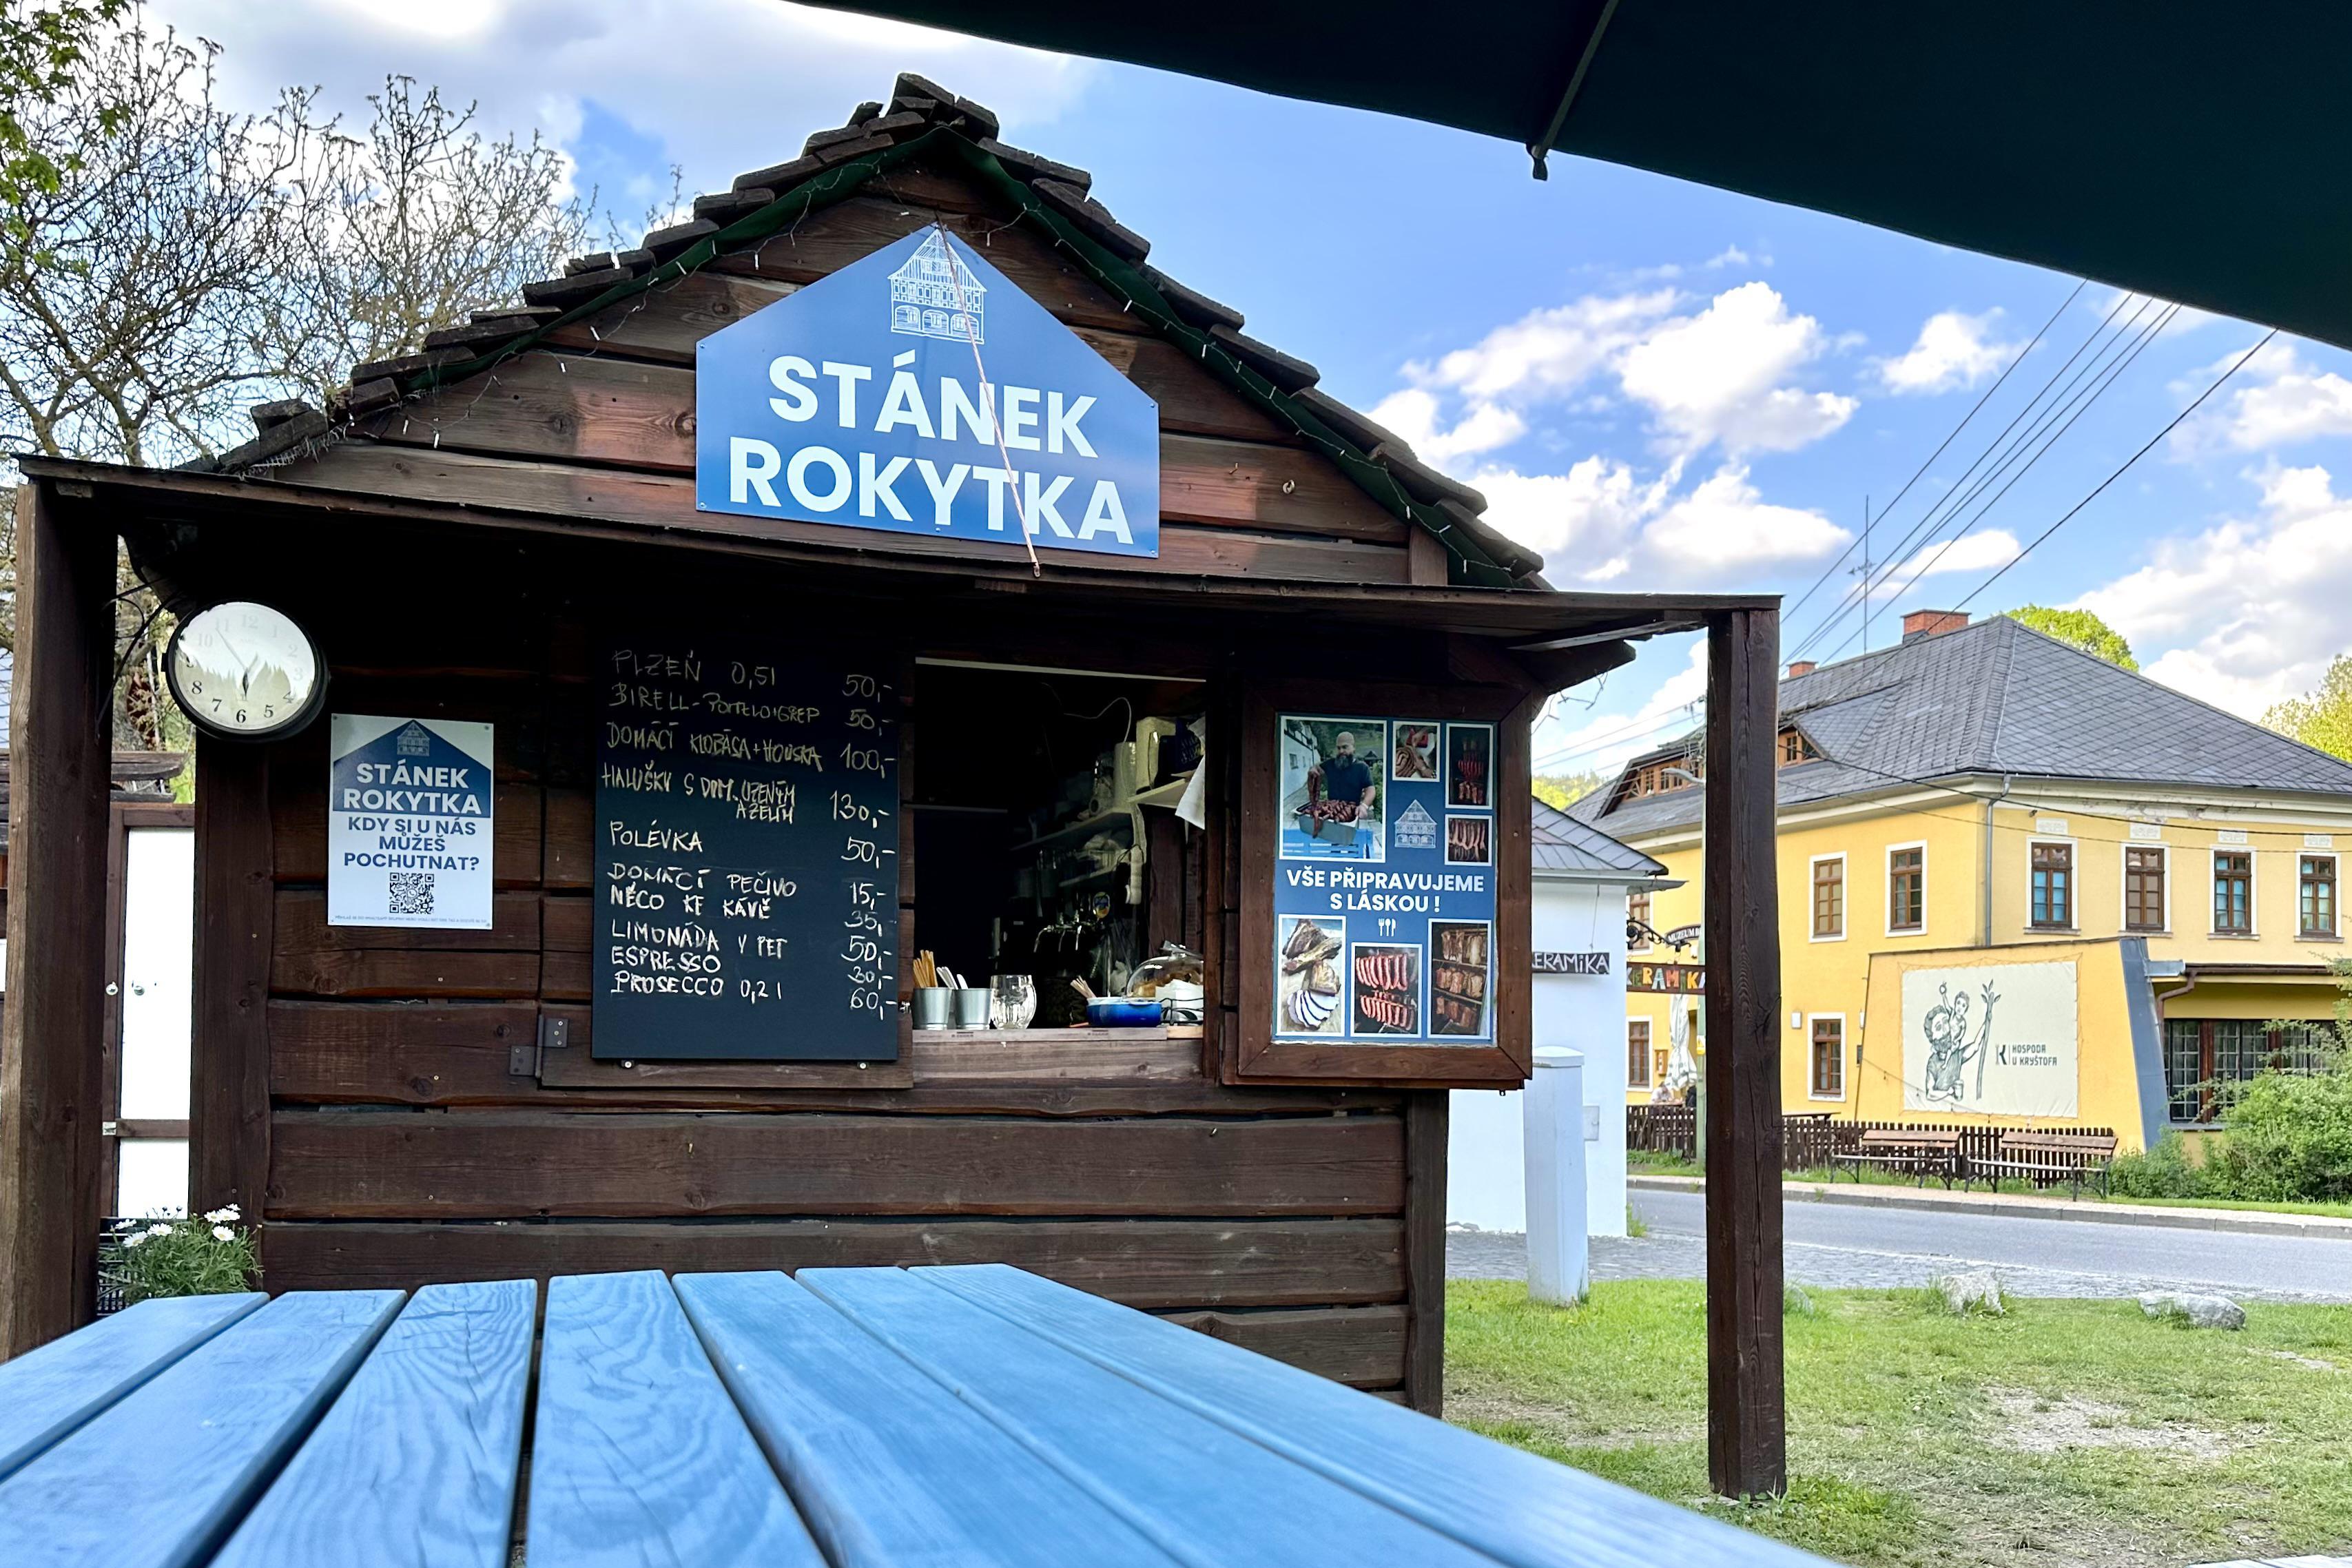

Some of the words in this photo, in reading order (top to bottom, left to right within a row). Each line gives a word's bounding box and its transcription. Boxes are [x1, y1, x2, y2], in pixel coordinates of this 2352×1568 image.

[769, 349, 1097, 457] STÁNEK
[730, 436, 1133, 544] ROKYTKA
[243, 614, 258, 628] 12
[198, 633, 213, 647] 10
[288, 644, 298, 657] 2
[192, 681, 203, 694] 8
[609, 682, 689, 710] BIRELL
[212, 698, 222, 712] 7
[264, 705, 274, 718] 5
[236, 709, 246, 723] 6
[356, 759, 469, 789] STÁNEK
[684, 773, 694, 795] S
[343, 788, 482, 815] ROKYTKA
[348, 816, 389, 832] KDY
[394, 818, 412, 833] SI
[417, 820, 430, 834] U
[435, 816, 476, 835] NÁS
[379, 831, 446, 852] MŮŽEŠ
[610, 820, 703, 853] POLÉVKA
[344, 853, 479, 871] POCHUTNAT?
[727, 871, 796, 896] PEČIVO
[1286, 865, 1325, 888] VŠE
[1330, 867, 1485, 893] PŘIPRAVUJEME
[610, 881, 665, 911] NĚCO
[683, 894, 704, 916] KE
[723, 897, 771, 920] KÁVĚ
[1330, 894, 1344, 911] S
[1347, 891, 1430, 912] LÁSKOU
[612, 919, 719, 952] LIMONÁDA
[757, 935, 787, 960] PET
[612, 947, 721, 973] ESPRESSO
[610, 971, 724, 996] PROSECCO
[2012, 1044, 2046, 1053] HOSPODA
[2012, 1058, 2017, 1066] U
[2019, 1055, 2057, 1066] KRYŠTOFA
